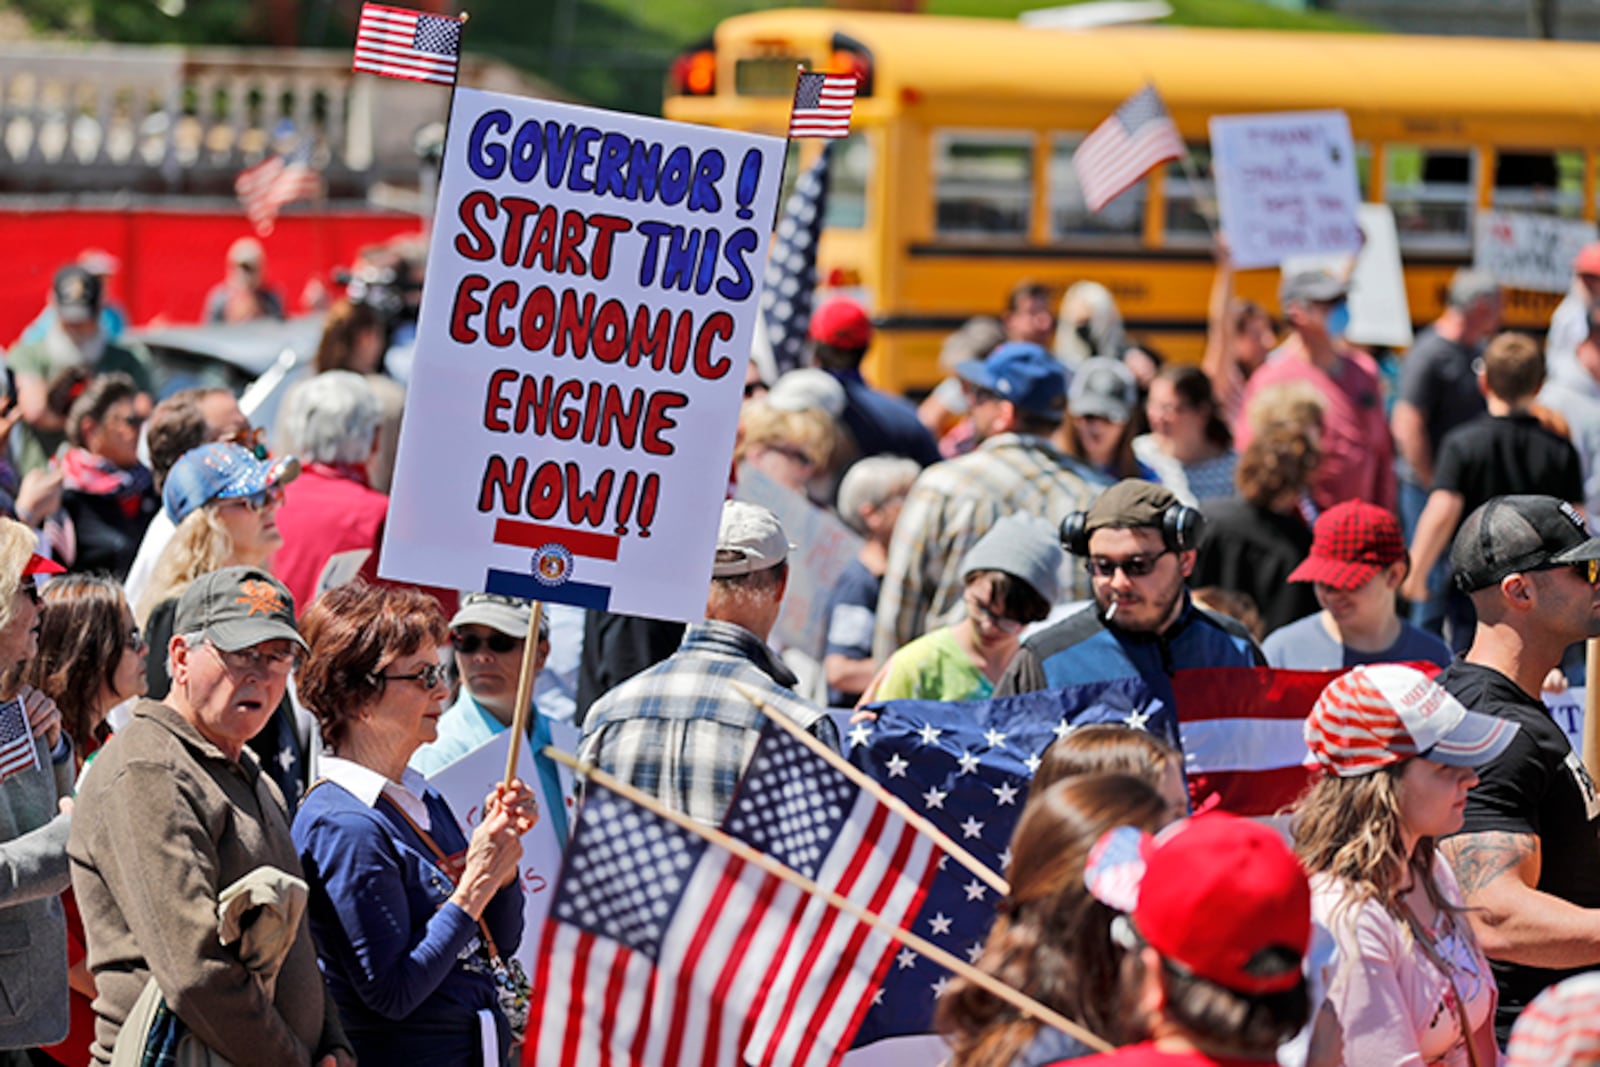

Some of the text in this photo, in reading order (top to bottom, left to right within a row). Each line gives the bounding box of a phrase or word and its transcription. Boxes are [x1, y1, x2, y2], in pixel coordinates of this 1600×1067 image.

[455, 190, 758, 301] START THIS
[450, 274, 734, 380] ECONOMIC
[484, 369, 689, 456] ENGINE
[477, 455, 660, 537] NOW!!
